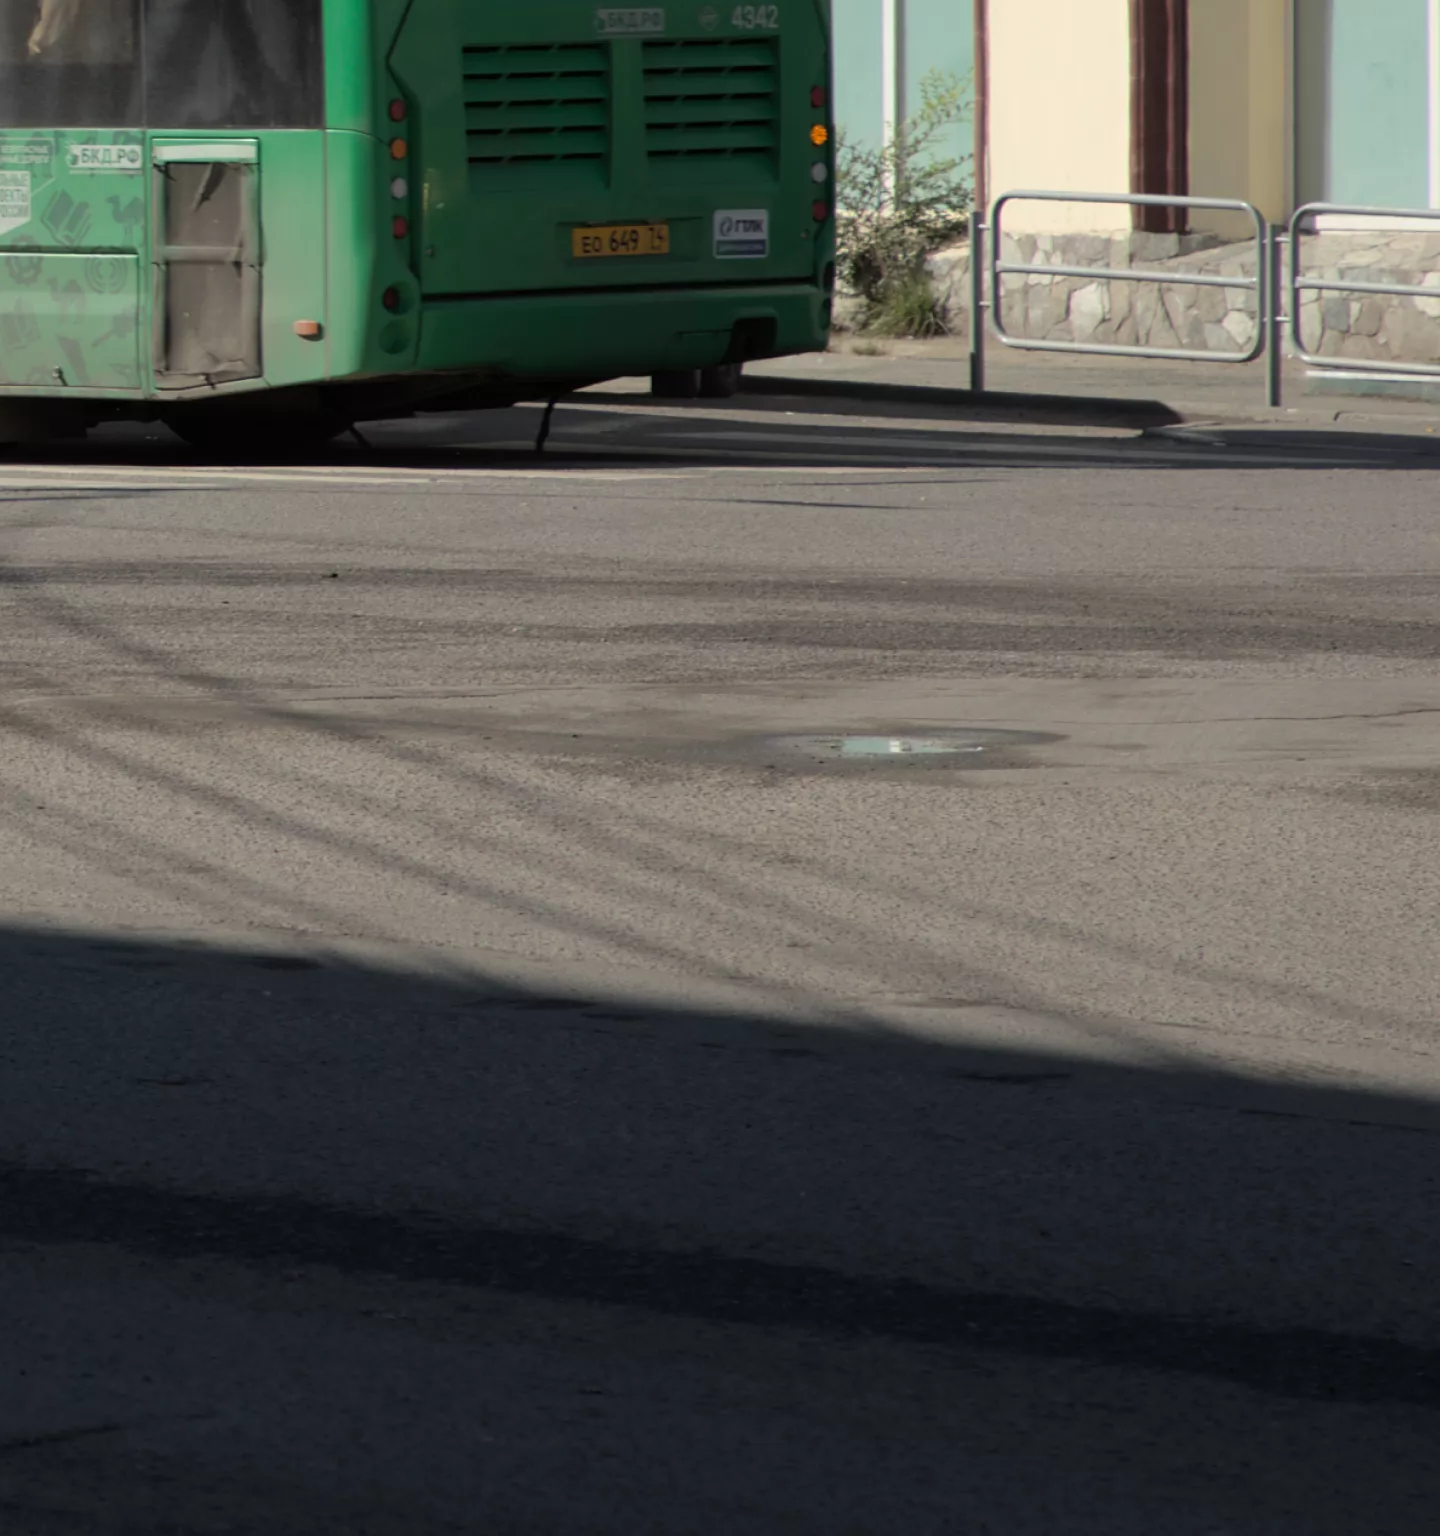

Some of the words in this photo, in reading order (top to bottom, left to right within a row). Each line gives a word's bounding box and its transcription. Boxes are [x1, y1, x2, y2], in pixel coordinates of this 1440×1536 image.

[731, 5, 779, 29] 4342
[81, 147, 140, 164] БКД.РФ
[609, 229, 639, 252] 649
